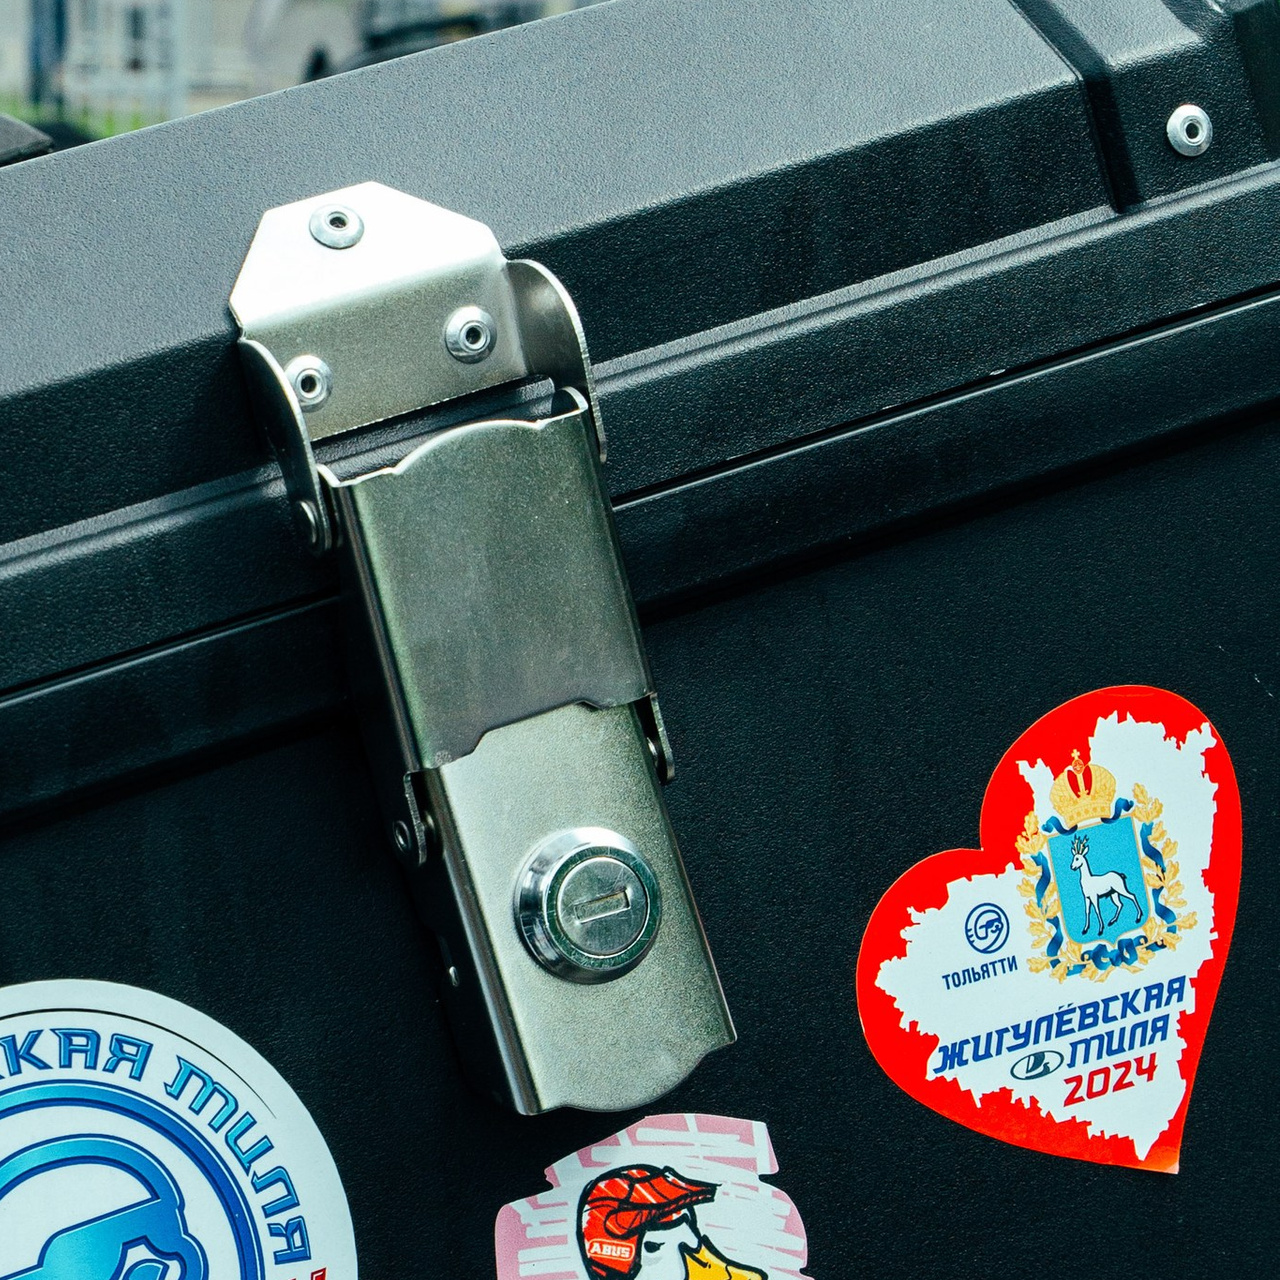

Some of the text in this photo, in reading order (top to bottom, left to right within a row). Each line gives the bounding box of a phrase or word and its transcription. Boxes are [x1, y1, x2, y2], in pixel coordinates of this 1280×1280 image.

[942, 955, 1018, 990] ТОЛЬЯТТИ
[933, 975, 1186, 1074] ЖИГУЛЁВСКАЯ
[1067, 1013, 1170, 1069] МИЛЯ
[1063, 1052, 1157, 1107] 2024
[164, 1055, 311, 1265] МИЛЯ
[590, 1242, 630, 1258] ABUS
